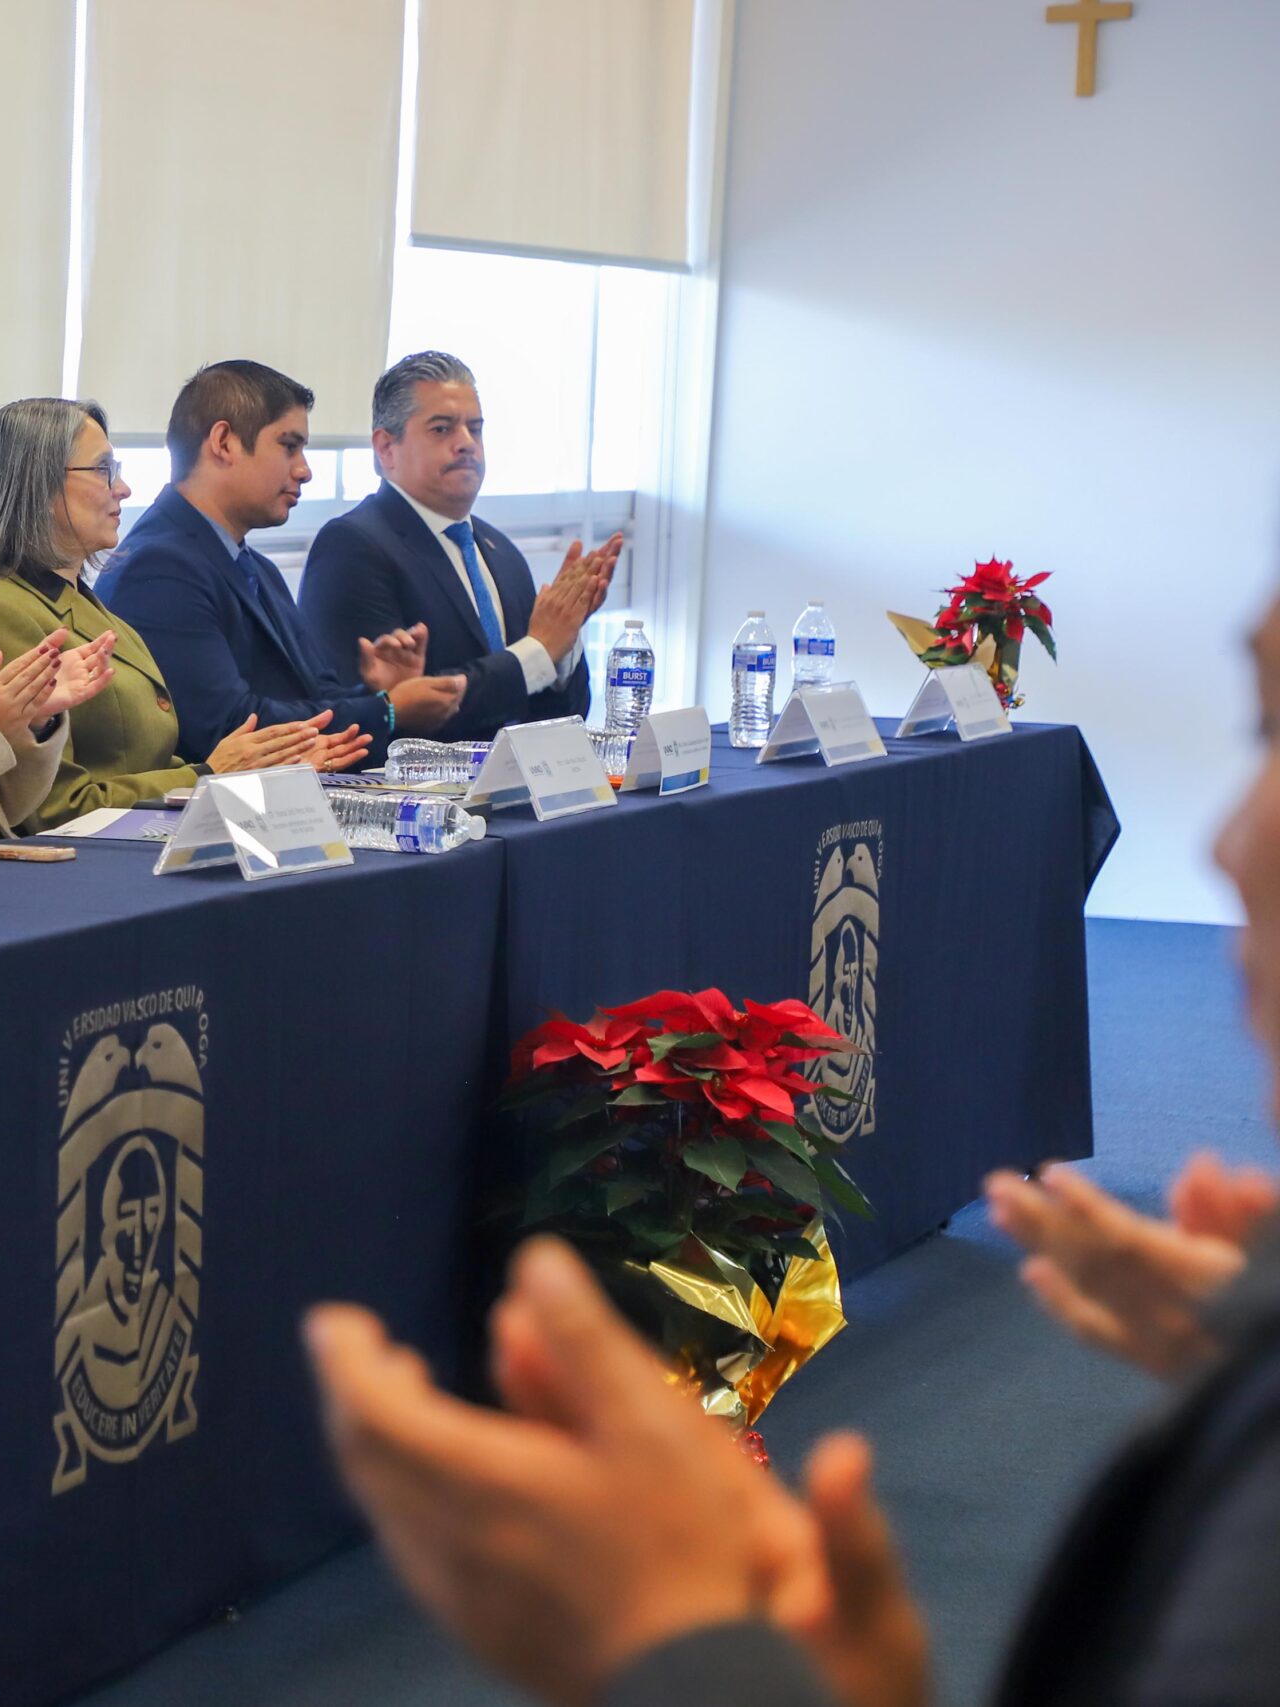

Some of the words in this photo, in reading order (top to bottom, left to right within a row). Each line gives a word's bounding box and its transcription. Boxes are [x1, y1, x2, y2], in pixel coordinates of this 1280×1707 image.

[623, 671, 648, 681] BURST
[58, 1002, 120, 1108] UNIVERSIDAD
[122, 992, 158, 1021] VASCO
[159, 989, 173, 1015] DE
[175, 984, 209, 1070] QUIROGA
[71, 1373, 118, 1440] EDUCERE
[121, 1412, 137, 1439] IN
[138, 1329, 184, 1427] VERITATE
